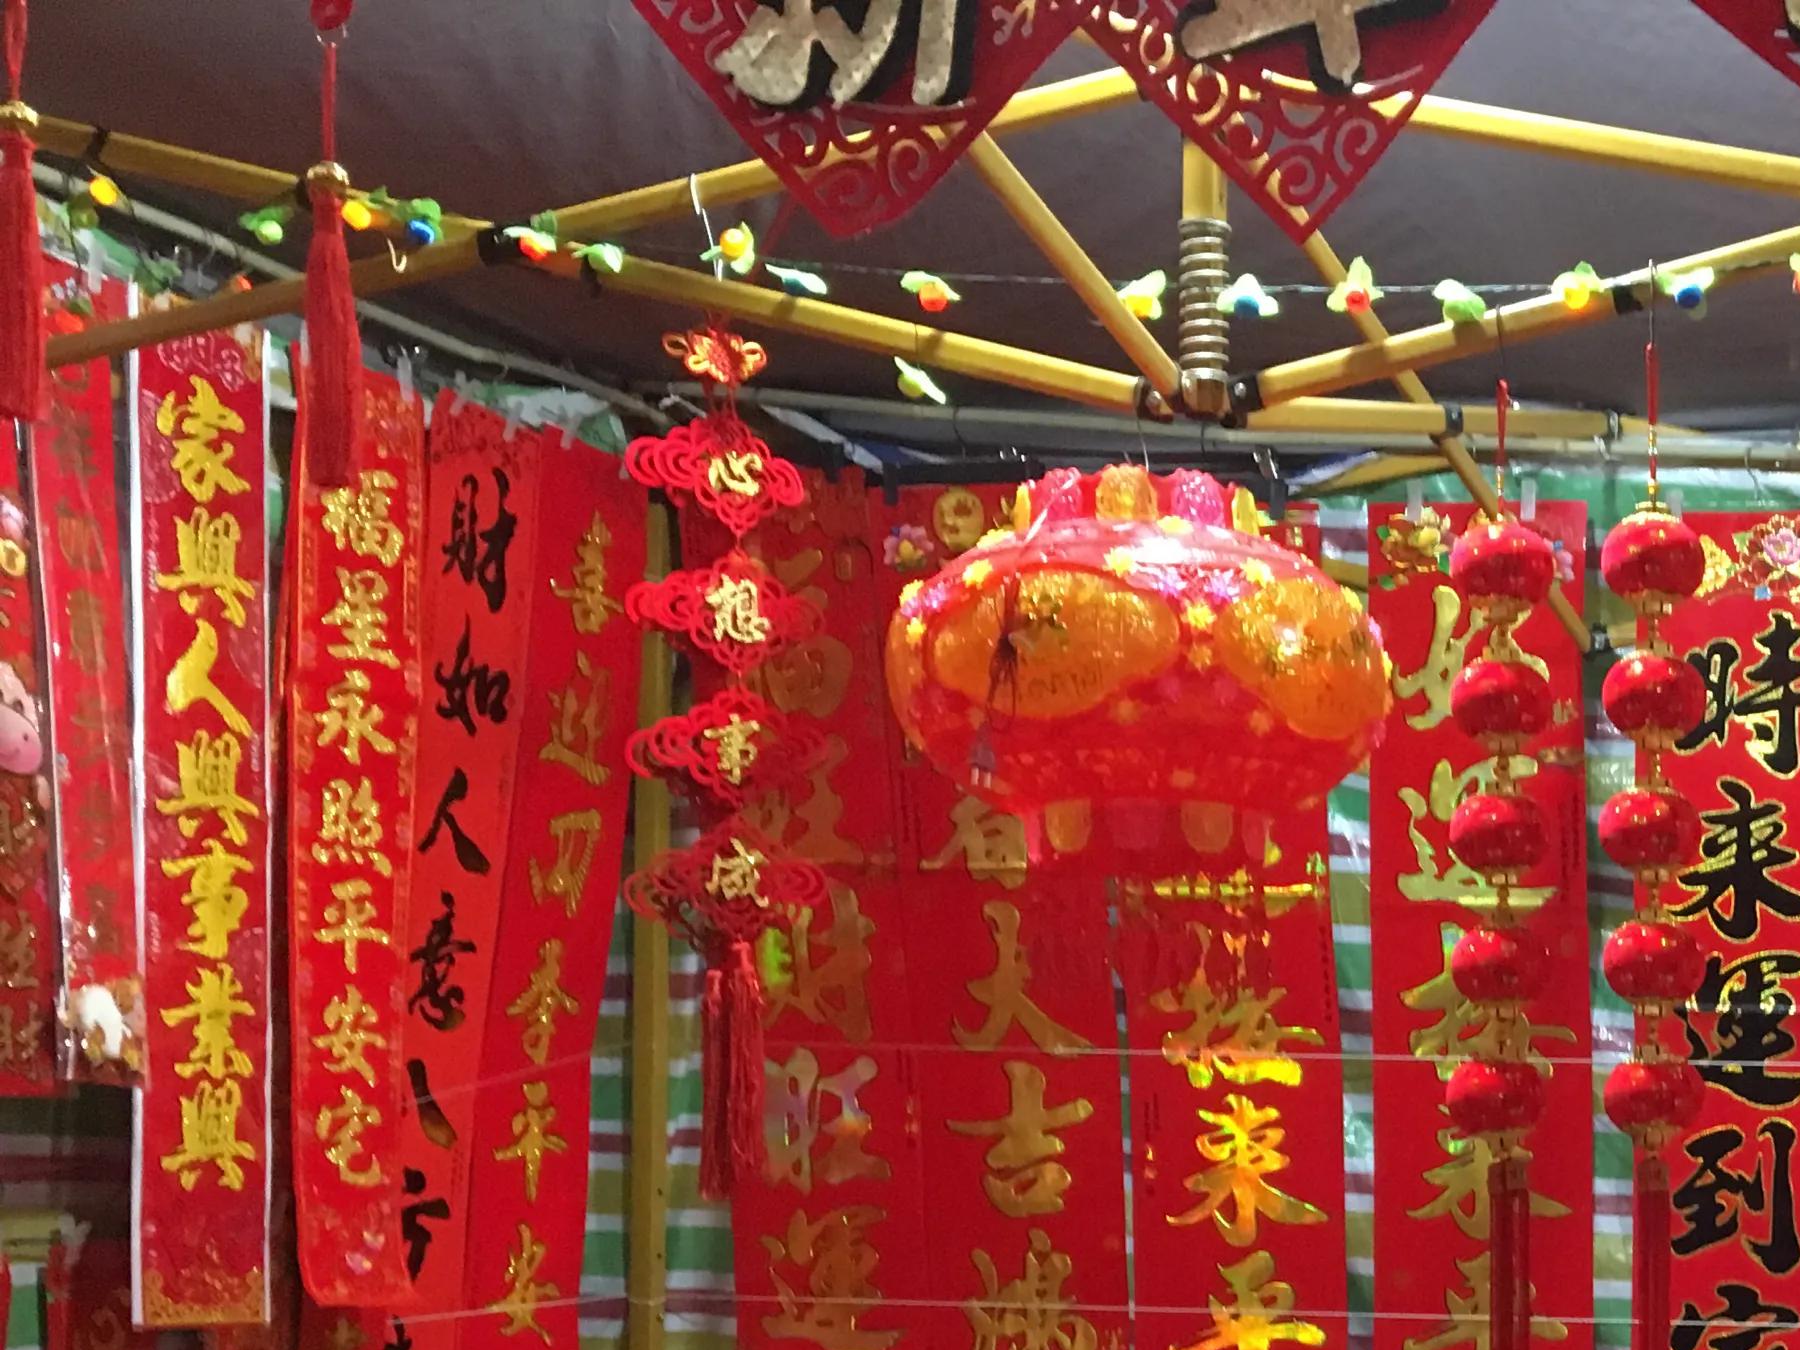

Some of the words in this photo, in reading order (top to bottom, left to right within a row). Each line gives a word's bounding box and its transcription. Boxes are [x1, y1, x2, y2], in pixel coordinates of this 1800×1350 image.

[156, 375, 256, 1191] 家興人興事業興
[312, 469, 405, 1187] 福星永照平安宅
[703, 449, 771, 908] 心想事成
